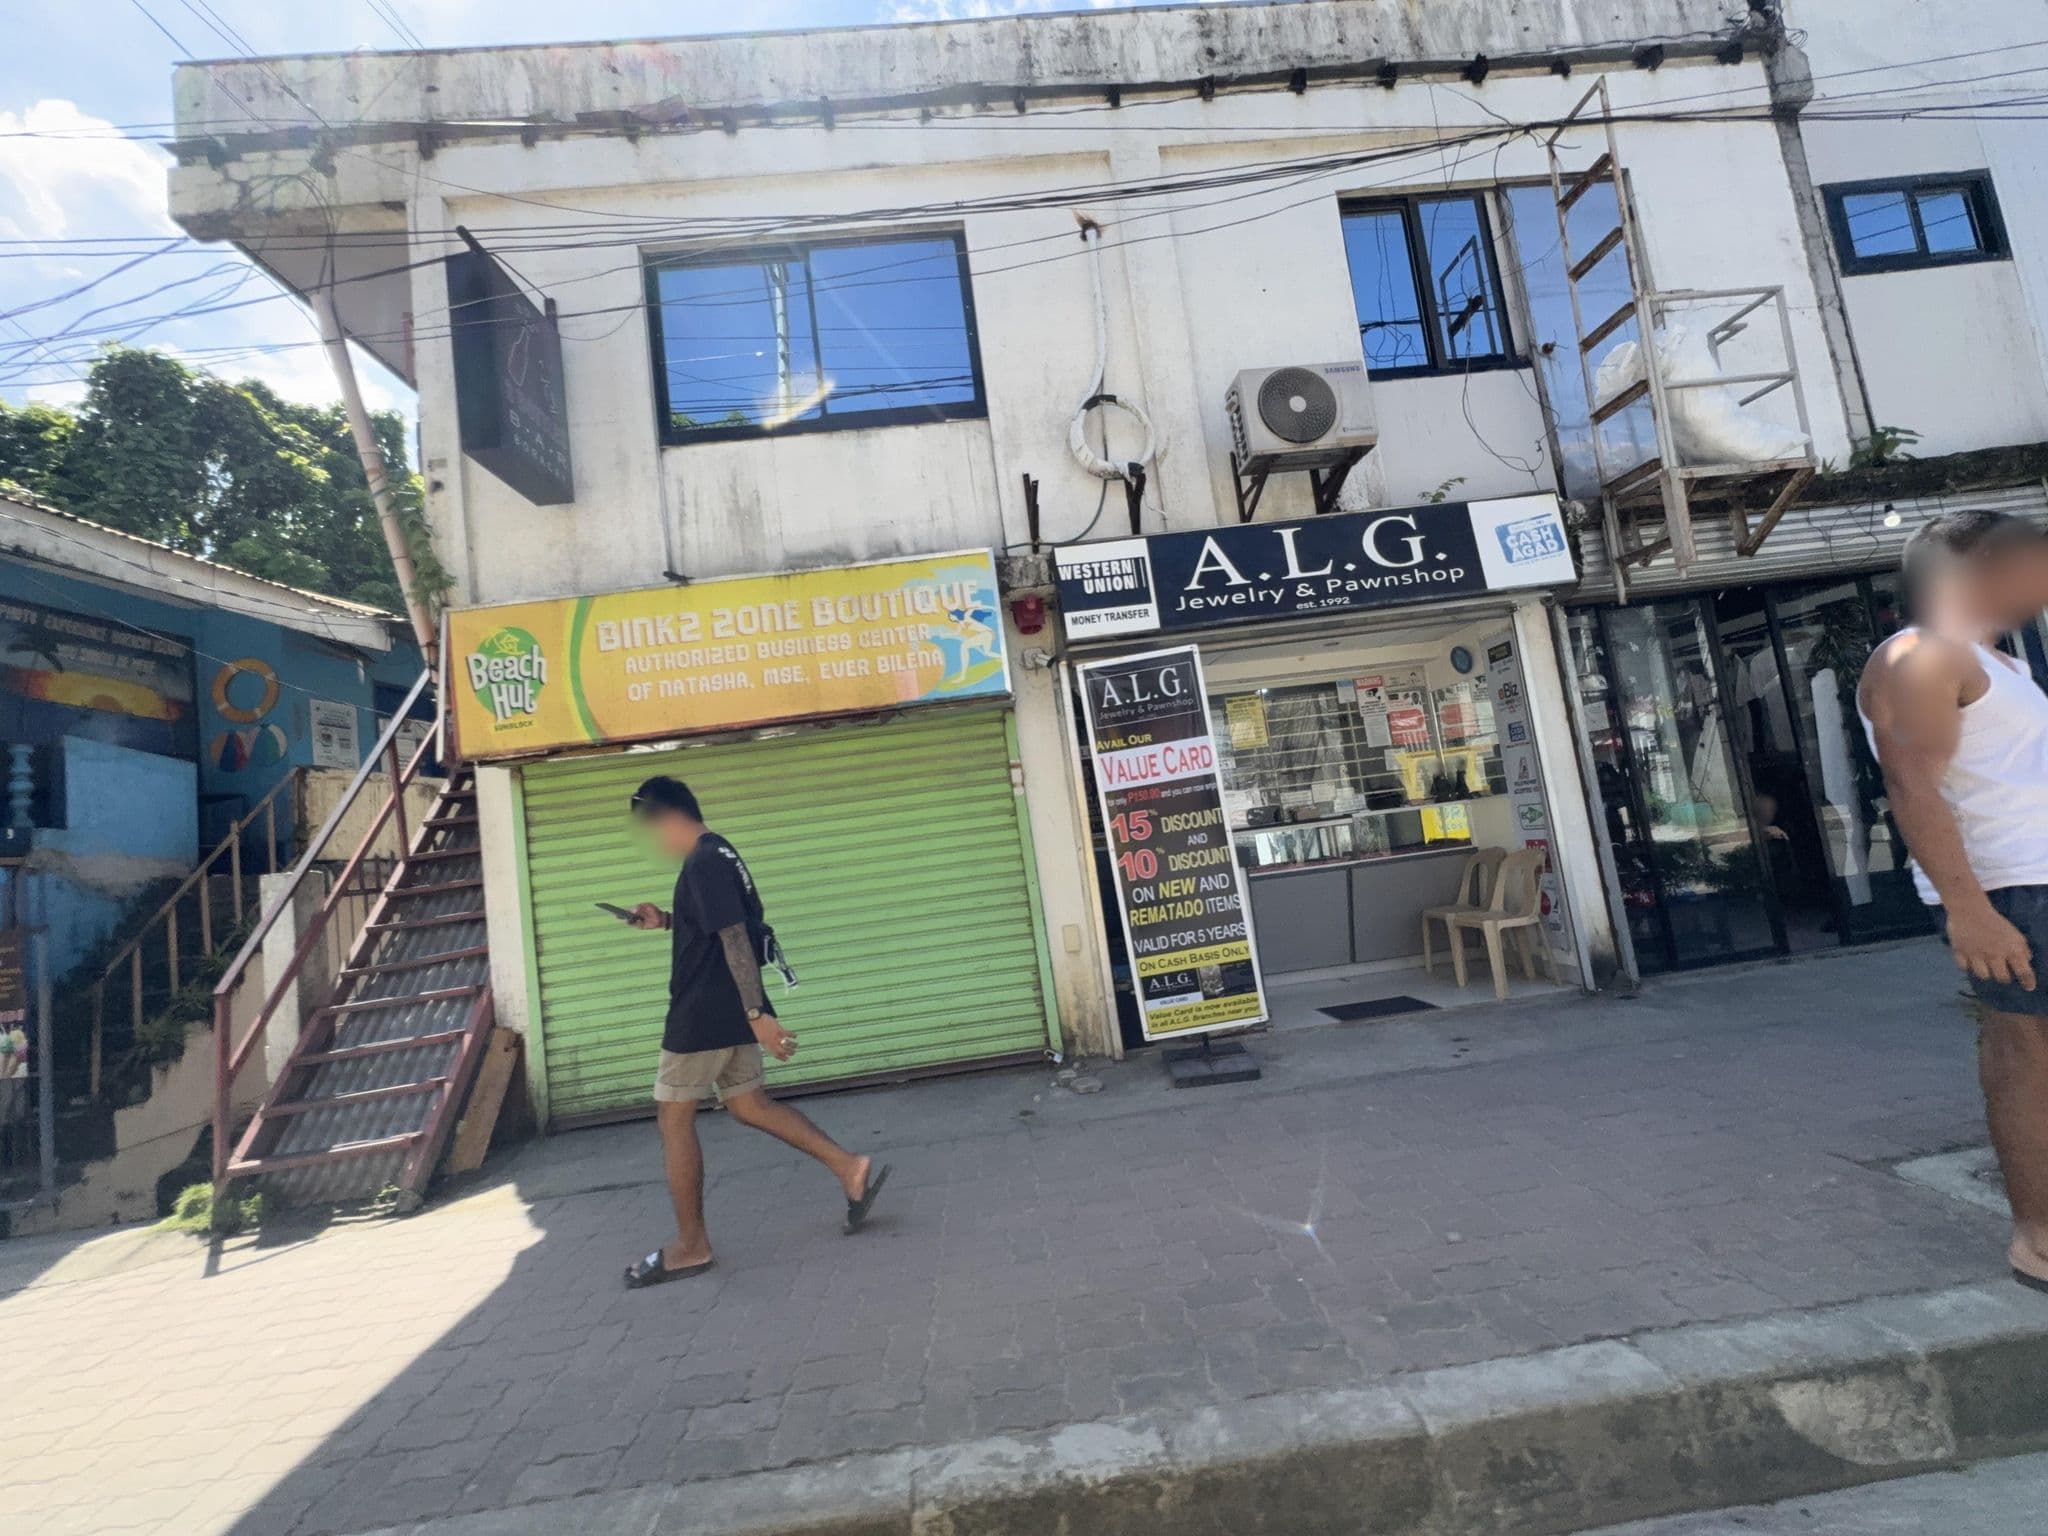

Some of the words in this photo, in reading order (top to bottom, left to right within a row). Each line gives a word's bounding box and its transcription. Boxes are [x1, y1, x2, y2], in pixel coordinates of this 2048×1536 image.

[1324, 365, 1361, 375] SAMSUNG
[1506, 525, 1555, 549] CASH
[1184, 513, 1448, 591] A.L.G.
[1512, 539, 1559, 562] AGAD
[1057, 559, 1133, 581] WESTERN
[1083, 574, 1135, 595] UNION
[1175, 587, 1285, 611] Jewelry
[1296, 583, 1316, 598] &
[1326, 565, 1465, 593] Pawnshop
[811, 579, 982, 627] BOUTIQUE
[1320, 596, 1350, 608] 1992
[1071, 614, 1102, 626] MONEY
[1104, 608, 1150, 622] TRANSFER
[625, 643, 749, 675] AUTHORIZED
[757, 632, 851, 660] BUSINESS
[858, 623, 931, 649] CENTER
[465, 644, 548, 693] Beach
[627, 682, 652, 702] OF
[819, 658, 871, 680] EVER
[877, 647, 944, 674] BILENA
[1101, 667, 1188, 708] A.L.G.
[1498, 681, 1519, 700] eBiz
[489, 680, 538, 725] Hut
[1100, 708, 1136, 720] Jewelry
[1138, 704, 1145, 714] &
[1147, 698, 1194, 712] Pawnshop
[1096, 739, 1129, 751] AVAIL
[1128, 734, 1152, 745] OUR
[1100, 753, 1162, 785] VALUE
[1163, 744, 1213, 774] CARD
[1160, 807, 1224, 833] DISCOUNT
[1187, 832, 1208, 846] AND
[1167, 846, 1231, 872] DISCOUNT
[1132, 886, 1155, 903] ON
[1158, 876, 1196, 899] NEW
[1199, 873, 1230, 893] AND
[1129, 899, 1204, 928] REMATADO
[1205, 893, 1241, 914] ITEMS
[1134, 935, 1169, 954] VALID
[1170, 930, 1197, 948] FOR
[1198, 929, 1206, 943] 5
[1205, 922, 1248, 940] YEARS
[1139, 961, 1155, 972] ON
[1157, 956, 1188, 969] CASH
[1189, 950, 1220, 963] BASIS
[1221, 945, 1250, 958] ONLY
[1149, 972, 1193, 990] A.L.G.
[1174, 1006, 1193, 1016] Card
